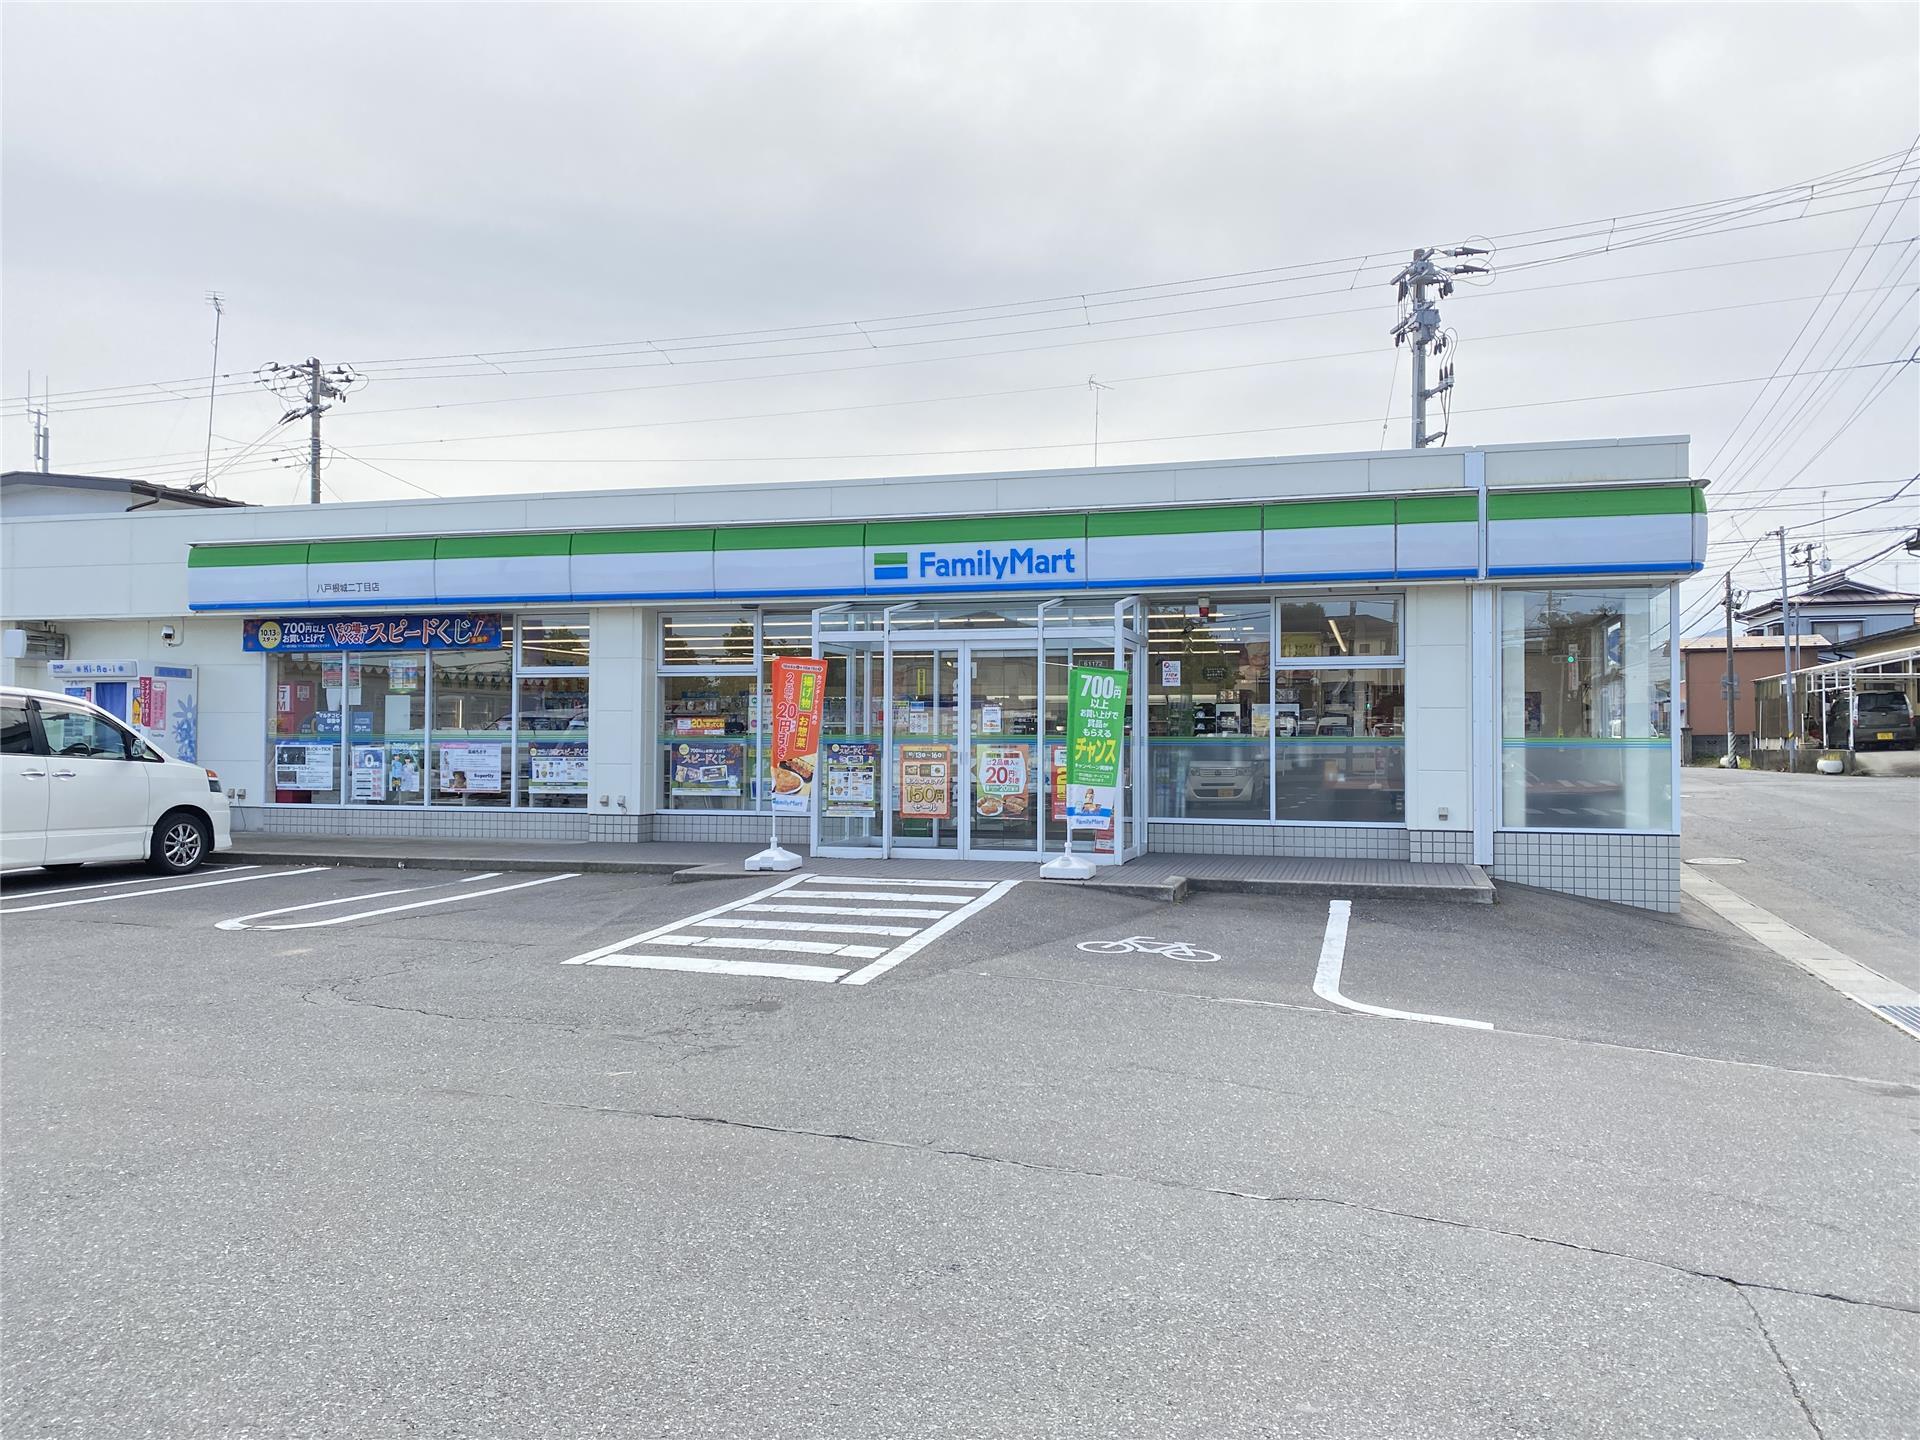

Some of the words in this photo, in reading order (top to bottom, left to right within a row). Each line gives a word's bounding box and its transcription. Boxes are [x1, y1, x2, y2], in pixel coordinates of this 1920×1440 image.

[920, 548, 1075, 579] FamilyMart
[317, 582, 380, 593] 八戸根城二丁目店
[283, 622, 326, 634] 700円以上
[365, 619, 472, 645] スピードくじ
[282, 634, 325, 643] お買い上げで
[801, 676, 814, 709] 揚げ物
[1090, 699, 1110, 709] 以上
[1080, 709, 1119, 719] お買い上げで
[796, 716, 809, 749] お惣菜
[1083, 728, 1112, 737] もらえる
[1075, 737, 1117, 763] チャンス
[681, 753, 727, 765] スピードくじ
[905, 785, 945, 803] 150円
